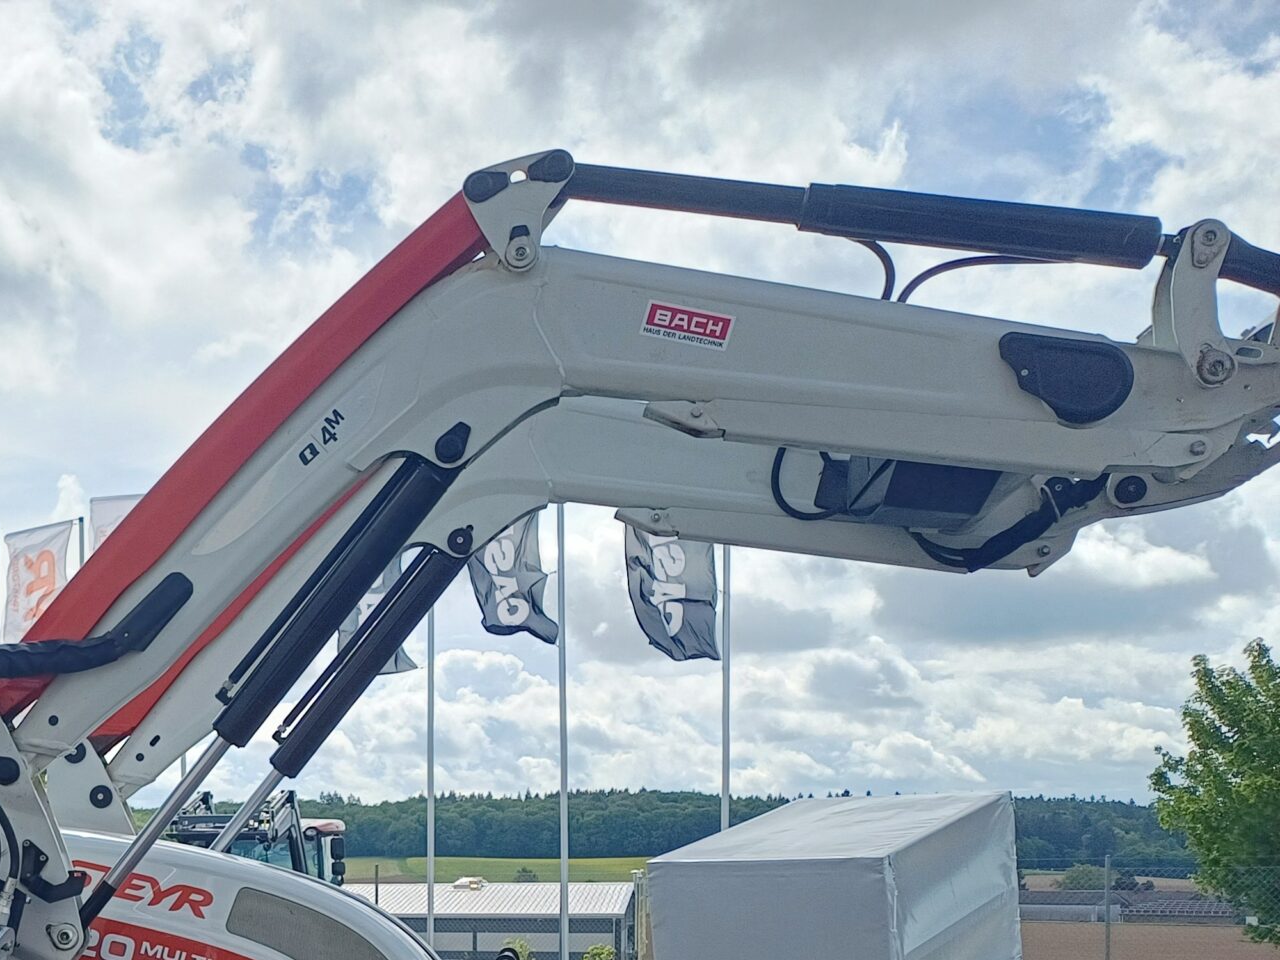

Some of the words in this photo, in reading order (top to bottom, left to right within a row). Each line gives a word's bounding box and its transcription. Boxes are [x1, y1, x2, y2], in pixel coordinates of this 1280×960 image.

[653, 309, 724, 337] BACH
[642, 326, 661, 336] HAUS
[663, 330, 677, 339] DER
[678, 333, 724, 348] LANDTECHNIK
